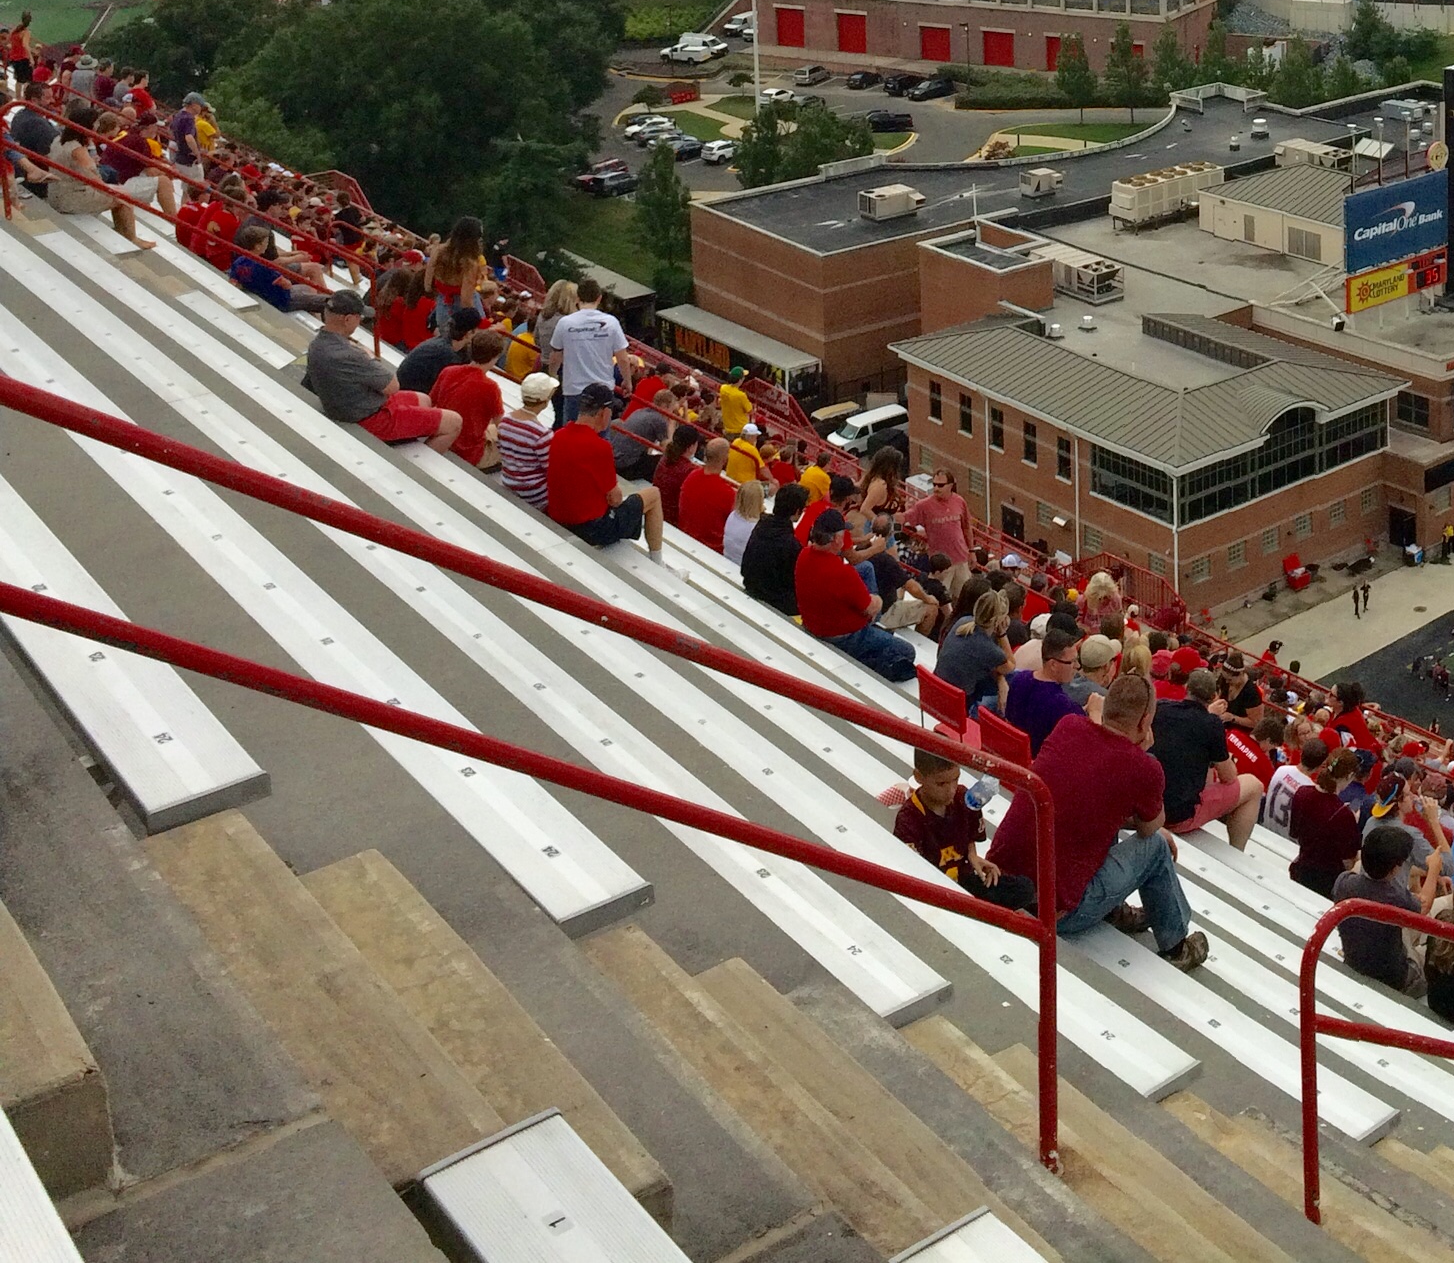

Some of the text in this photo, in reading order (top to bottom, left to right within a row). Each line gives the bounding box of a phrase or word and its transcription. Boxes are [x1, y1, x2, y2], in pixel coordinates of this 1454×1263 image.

[1353, 209, 1444, 242] Capital One Bank
[1371, 273, 1405, 290] MARYLAND
[1425, 268, 1439, 284] 35
[1371, 284, 1399, 301] LOTTERY
[89, 652, 106, 662] 23
[154, 733, 174, 745] 24
[1228, 733, 1258, 763] TERRAPINS
[461, 767, 477, 778] 23
[542, 846, 560, 858] 24
[757, 869, 772, 879] 23
[847, 946, 863, 956] 24
[1000, 955, 1014, 965] 23
[1208, 1019, 1222, 1029] 23
[1101, 1031, 1116, 1041] 24
